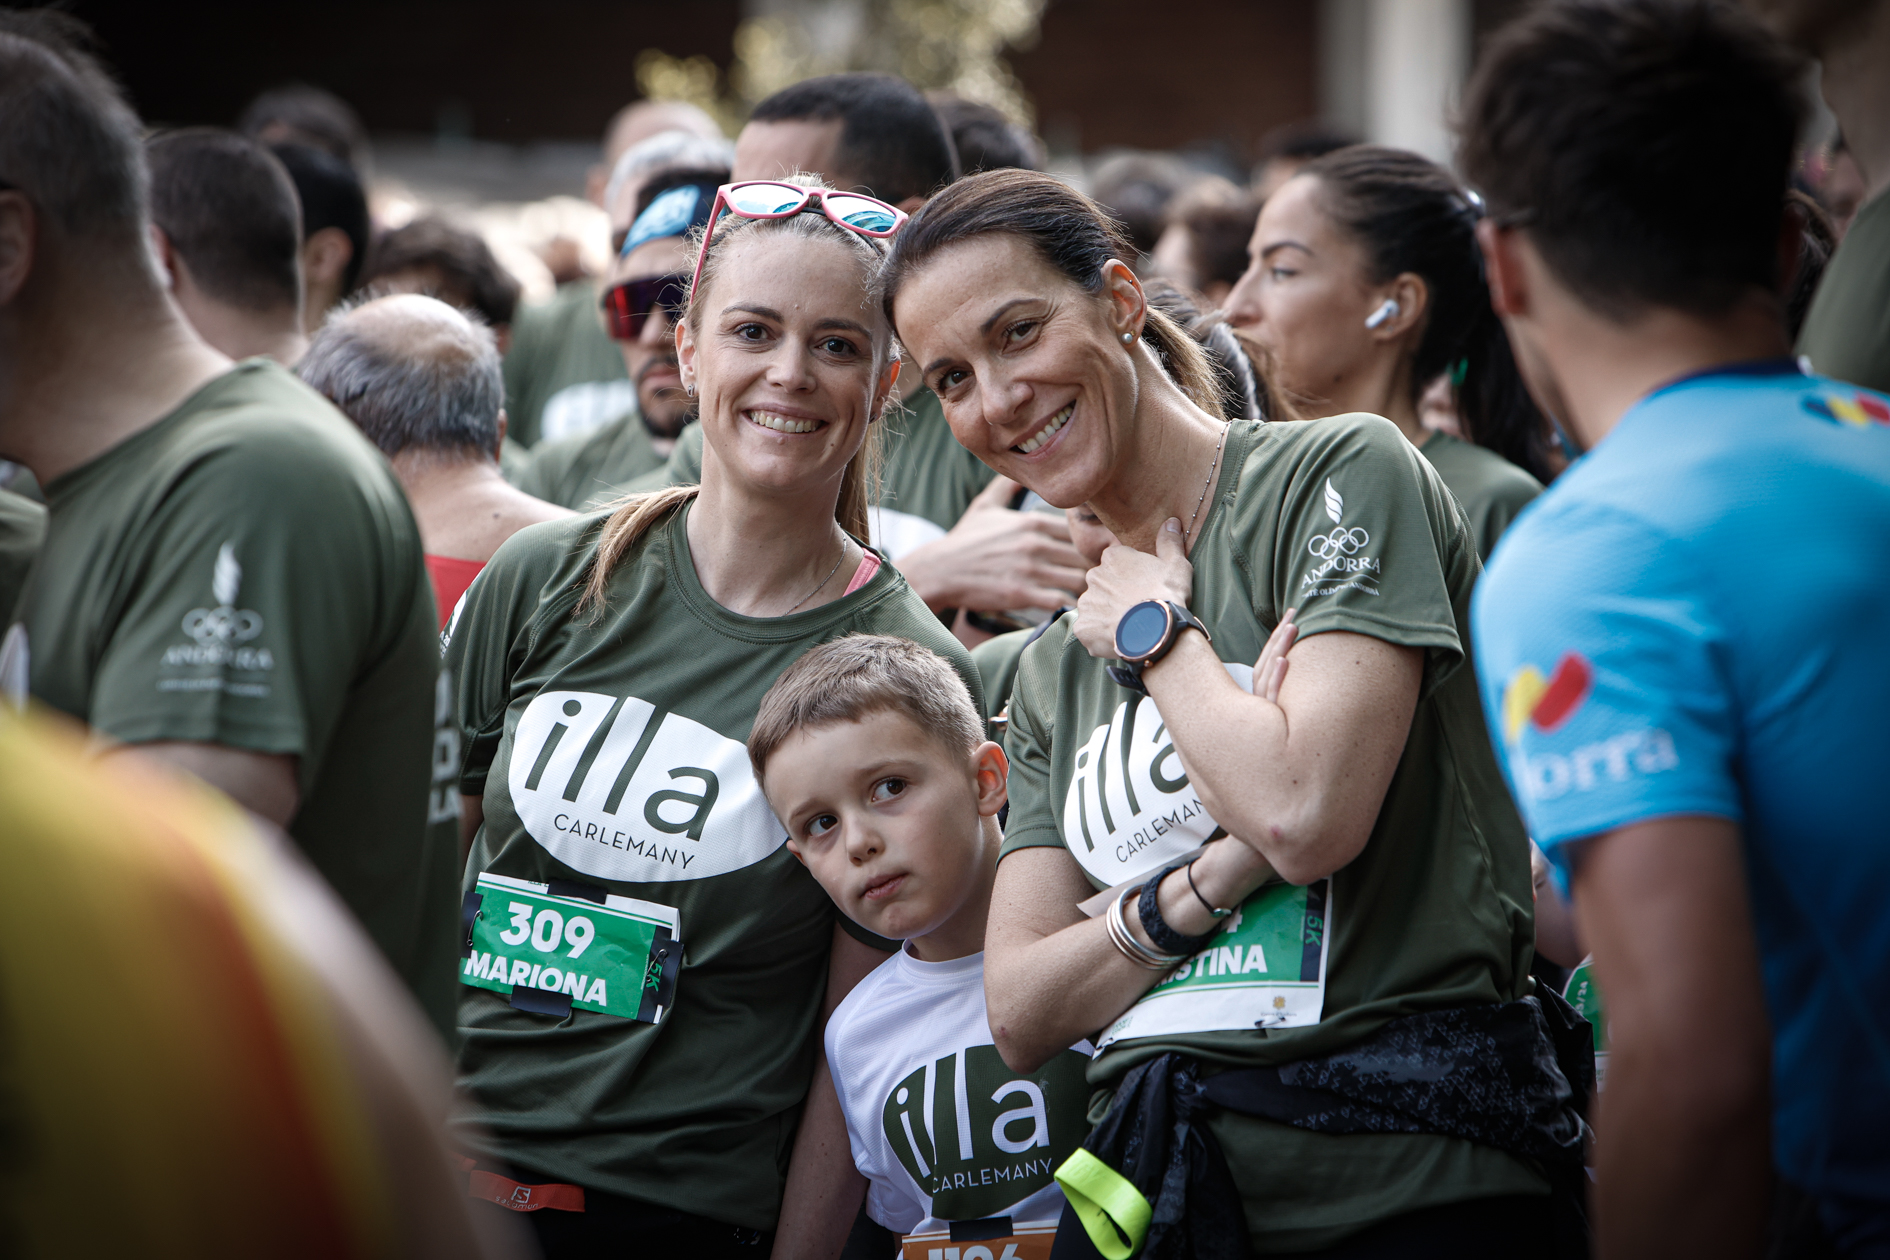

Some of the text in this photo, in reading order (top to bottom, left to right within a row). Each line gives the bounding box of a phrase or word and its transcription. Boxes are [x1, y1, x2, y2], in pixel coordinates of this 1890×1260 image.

[1301, 556, 1381, 589] ANDORRA
[525, 696, 720, 842] illa
[554, 813, 696, 870] CARLEMANY
[1115, 798, 1204, 863] CARLEMAN
[499, 900, 596, 959] 309
[1304, 914, 1324, 948] 5K
[463, 949, 608, 1007] MARIONA
[645, 960, 663, 993] 5K
[896, 1050, 1050, 1179] illa
[932, 1157, 1053, 1194] CARLEMANY
